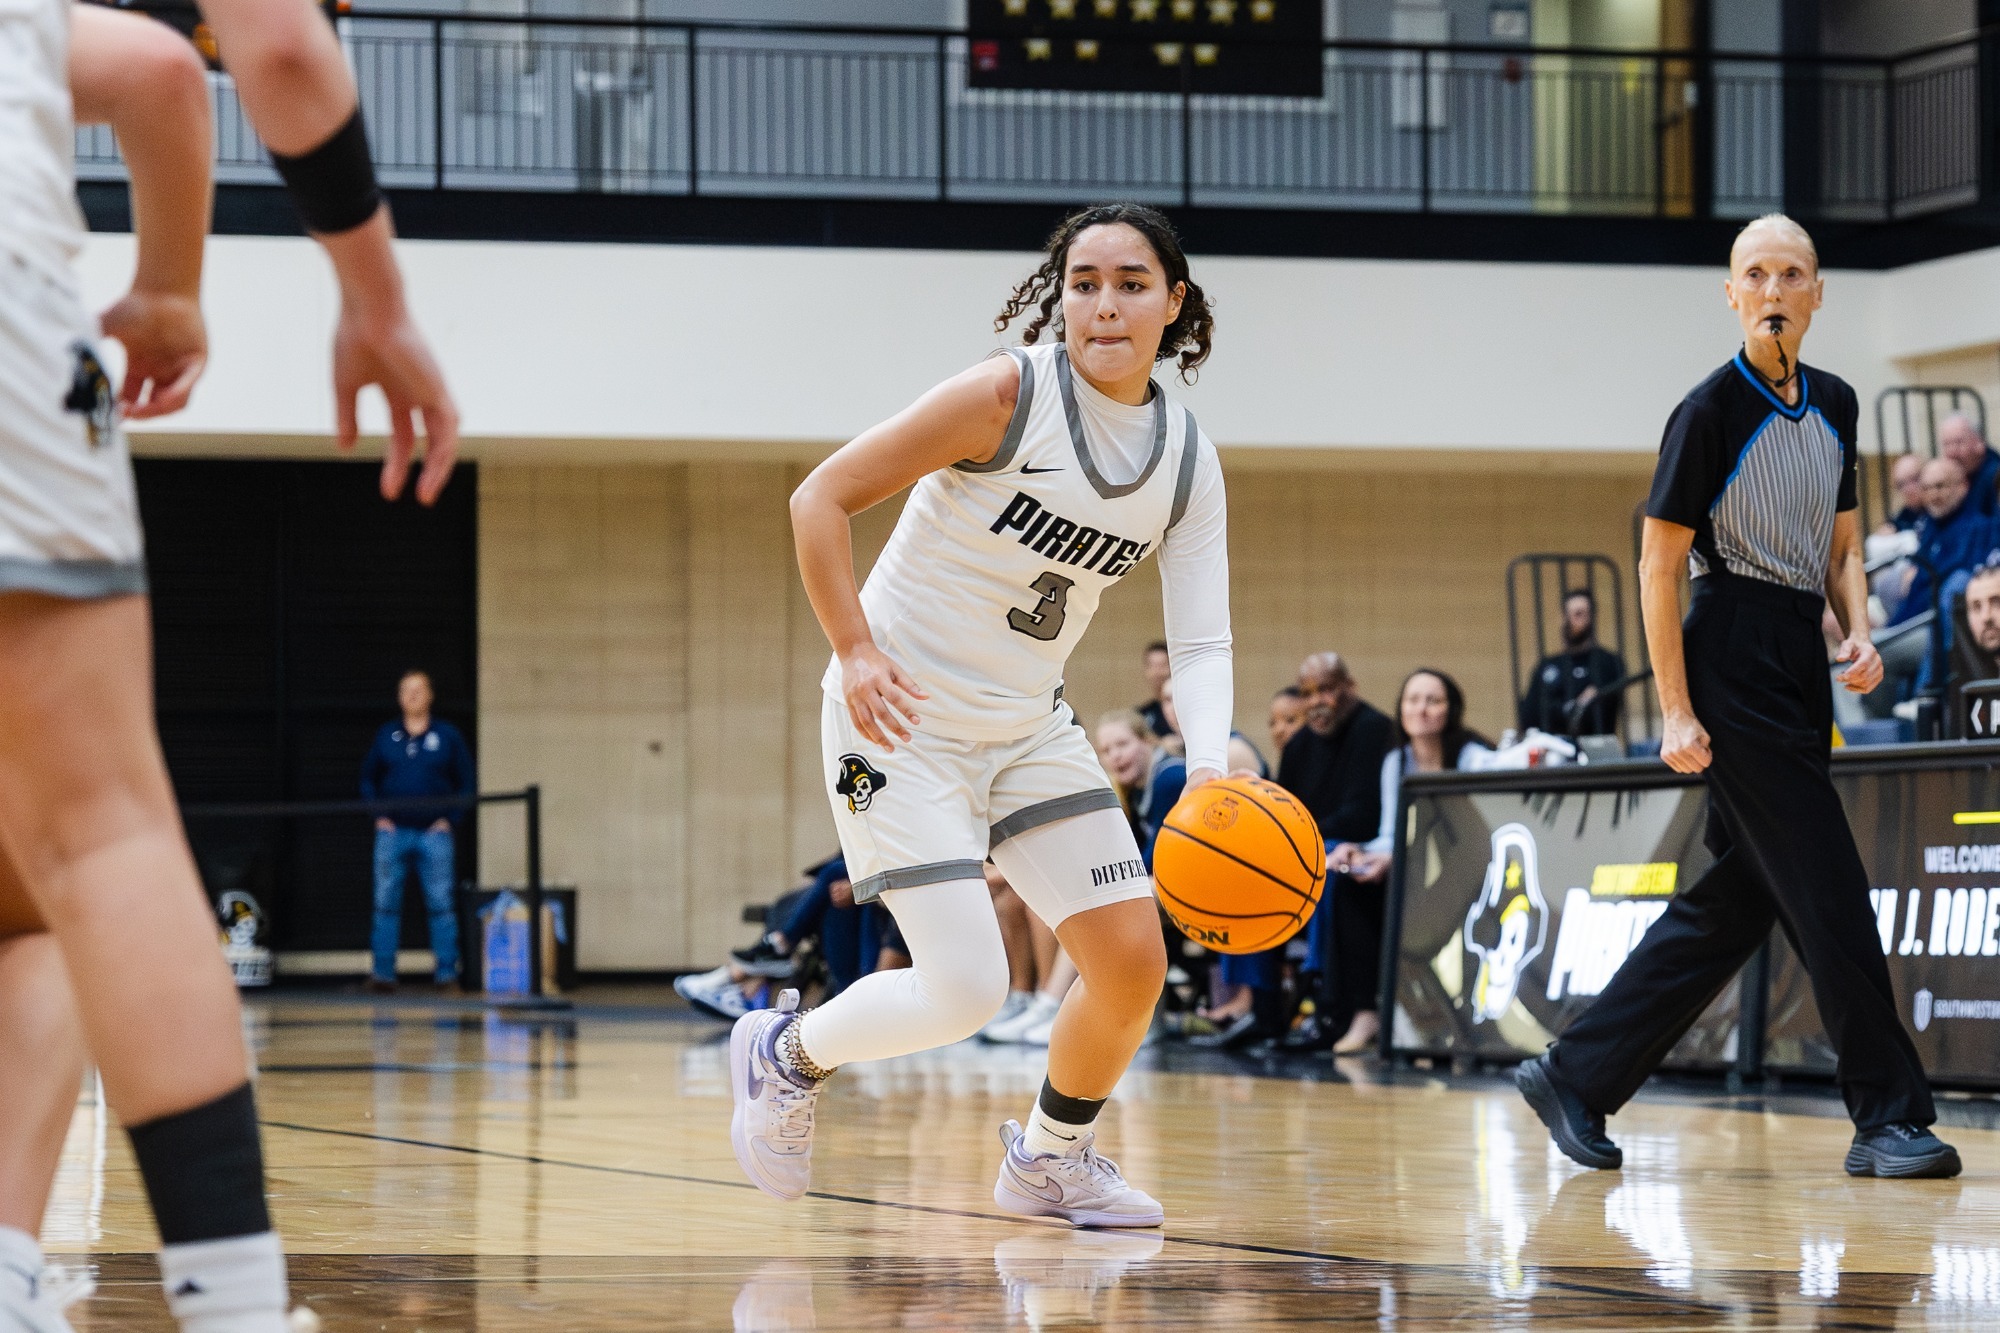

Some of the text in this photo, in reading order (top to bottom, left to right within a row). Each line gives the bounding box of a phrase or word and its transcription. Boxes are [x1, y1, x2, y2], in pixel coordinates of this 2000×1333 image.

[989, 491, 1151, 578] PIRATES
[1006, 571, 1075, 641] 3
[1928, 887, 2000, 957] ROBE
